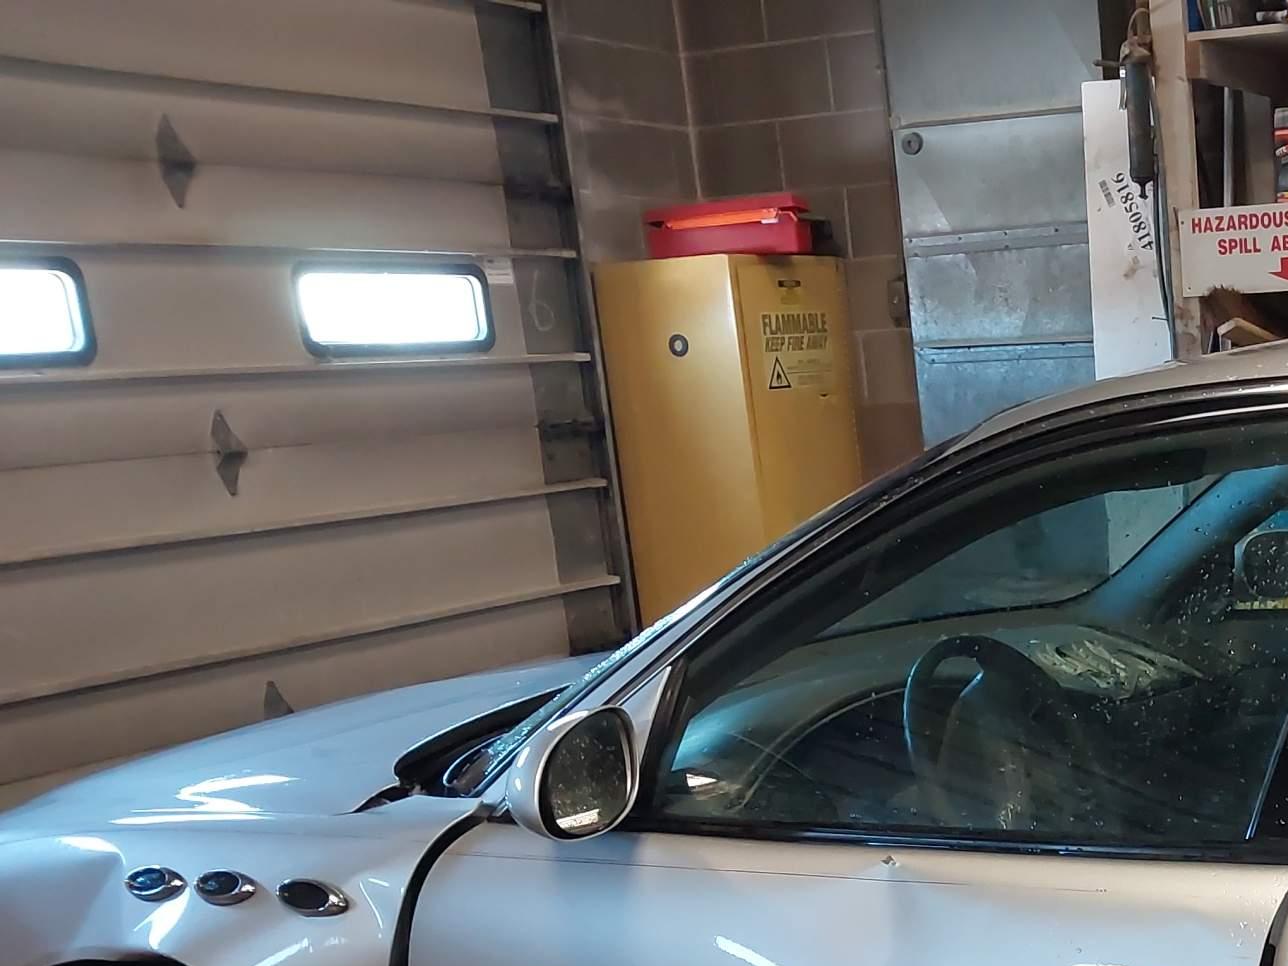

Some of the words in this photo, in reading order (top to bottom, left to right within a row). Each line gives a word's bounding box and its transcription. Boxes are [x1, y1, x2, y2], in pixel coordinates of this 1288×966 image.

[1110, 172, 1154, 250] 41805816
[1217, 237, 1261, 256] SPILL
[761, 312, 828, 336] FLAMMABLE
